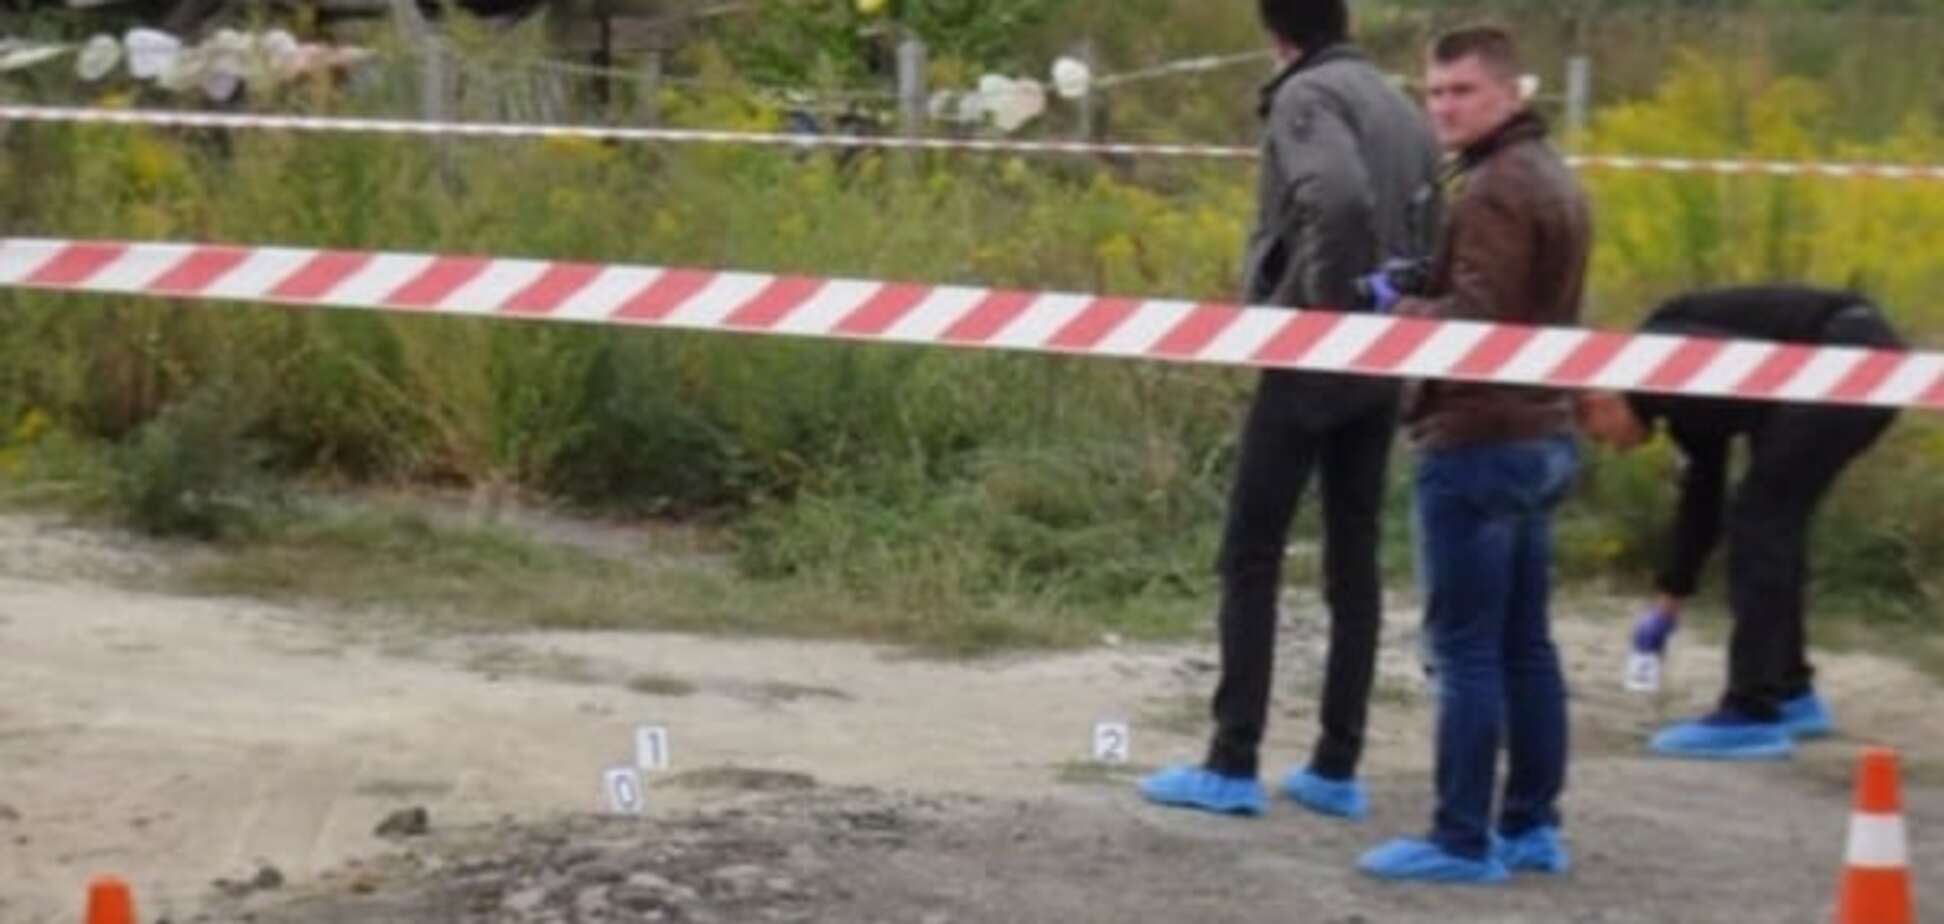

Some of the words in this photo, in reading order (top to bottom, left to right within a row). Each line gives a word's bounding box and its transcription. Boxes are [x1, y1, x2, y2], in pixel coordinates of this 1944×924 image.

[645, 731, 662, 766] 1
[1101, 728, 1123, 760] 2
[613, 772, 638, 809] 0
